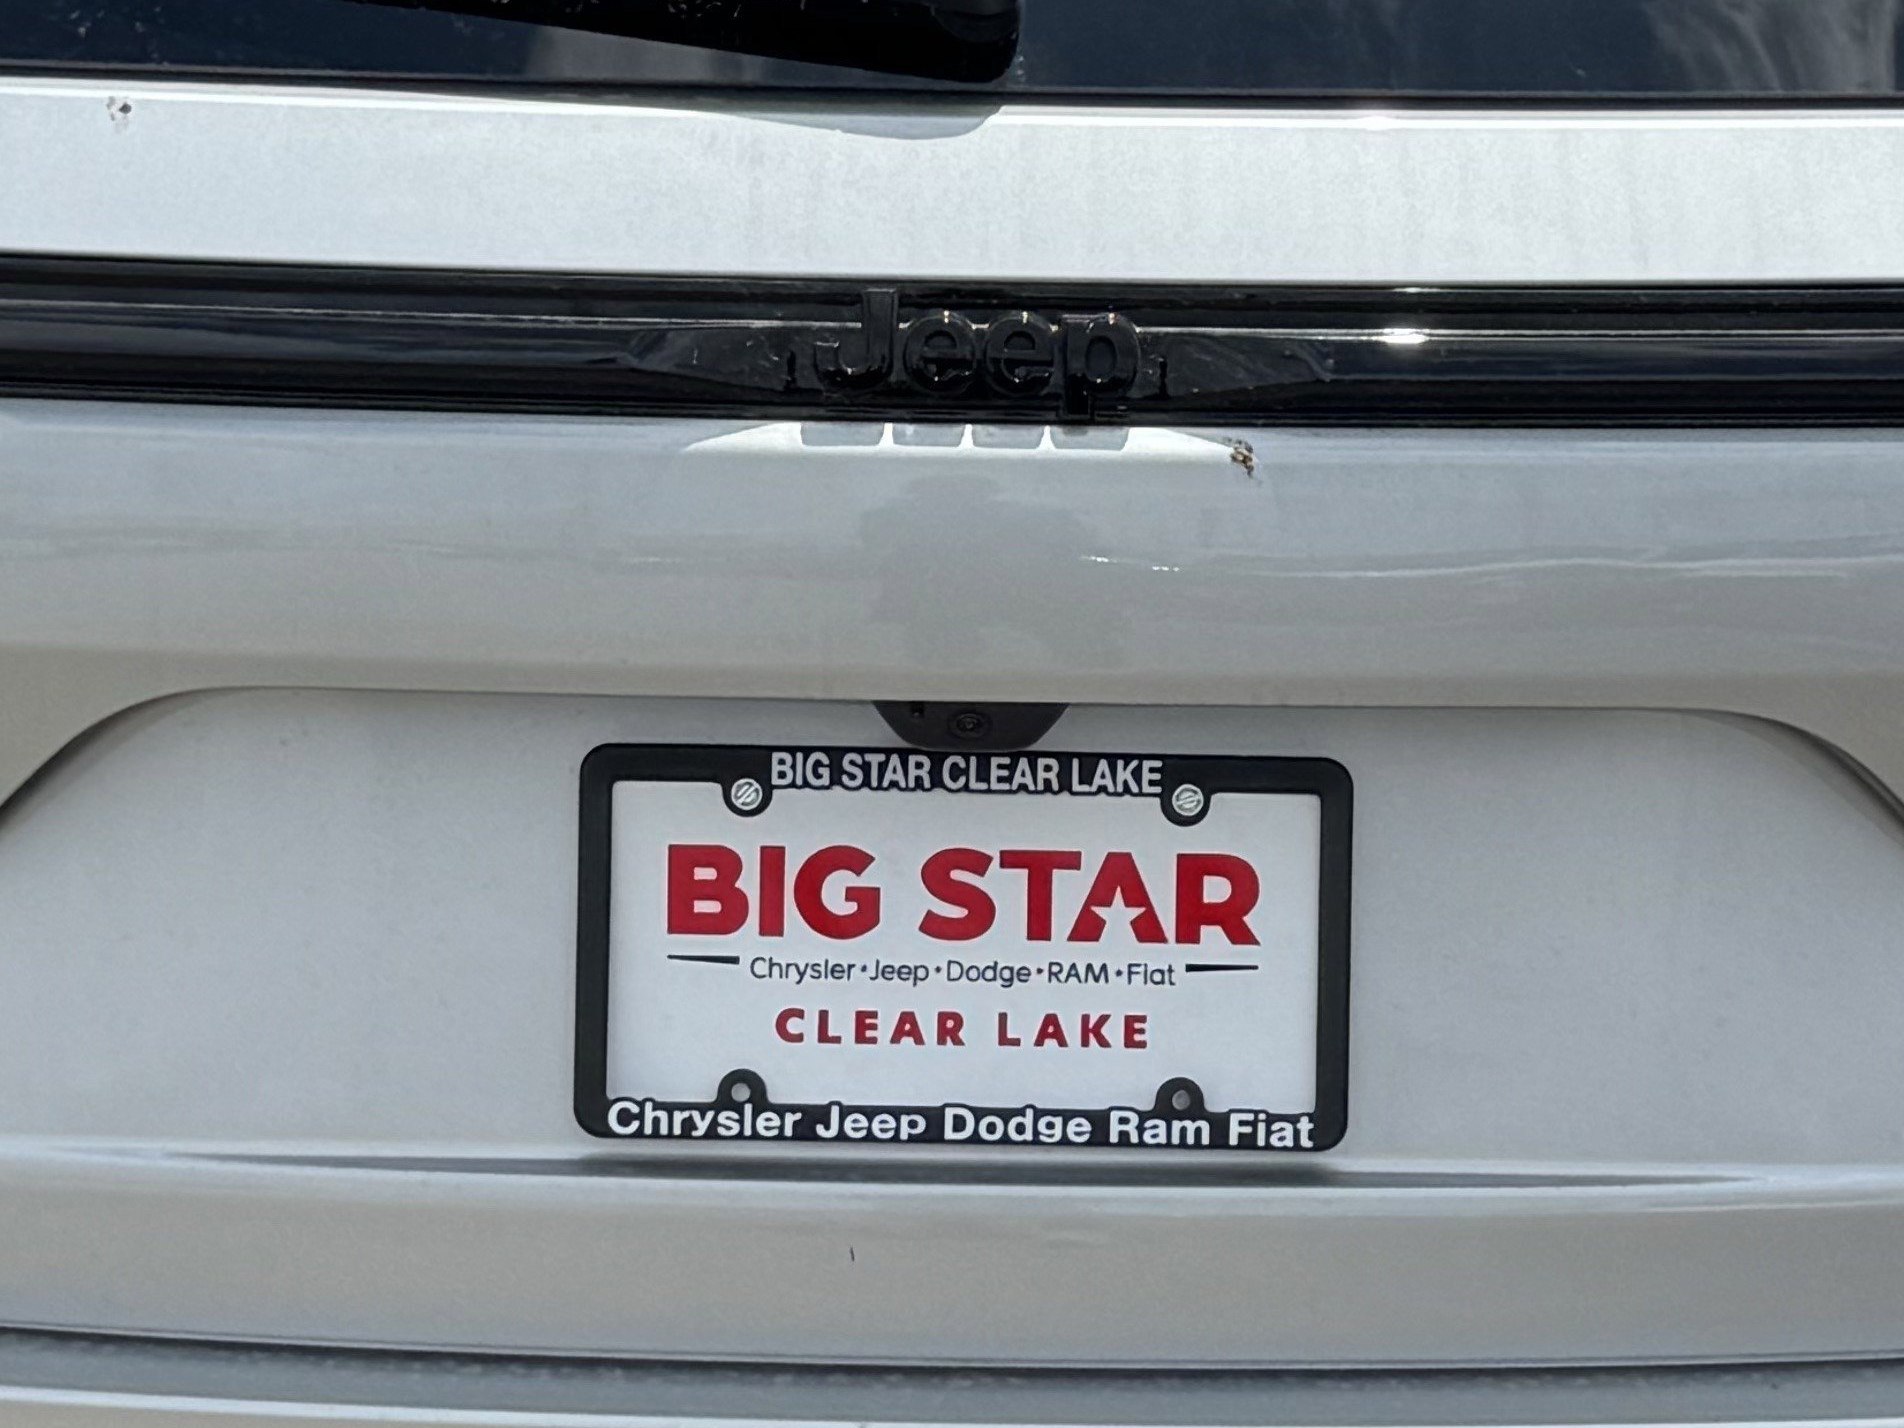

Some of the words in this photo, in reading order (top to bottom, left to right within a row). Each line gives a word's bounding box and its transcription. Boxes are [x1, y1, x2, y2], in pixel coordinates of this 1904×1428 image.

[813, 288, 1140, 419] Jeep
[771, 751, 830, 786] BIG
[842, 753, 931, 788] STAR
[942, 755, 1059, 791] CLEAR
[1071, 758, 1163, 793] LAKE
[667, 844, 881, 940] BIG
[918, 847, 1261, 946] STAR
[750, 956, 855, 984] Chrysler
[869, 959, 929, 987] Jeep
[946, 959, 1032, 988] Dodge
[1047, 962, 1109, 984] RAM
[775, 1007, 965, 1046] CLEAR
[998, 1012, 1148, 1049] LAKE
[607, 1100, 802, 1138] Chrysler
[815, 1104, 927, 1141] Jeep
[943, 1106, 1092, 1144] Dodge
[1109, 1109, 1211, 1145] Ram
[1228, 1112, 1315, 1148] Fiat
